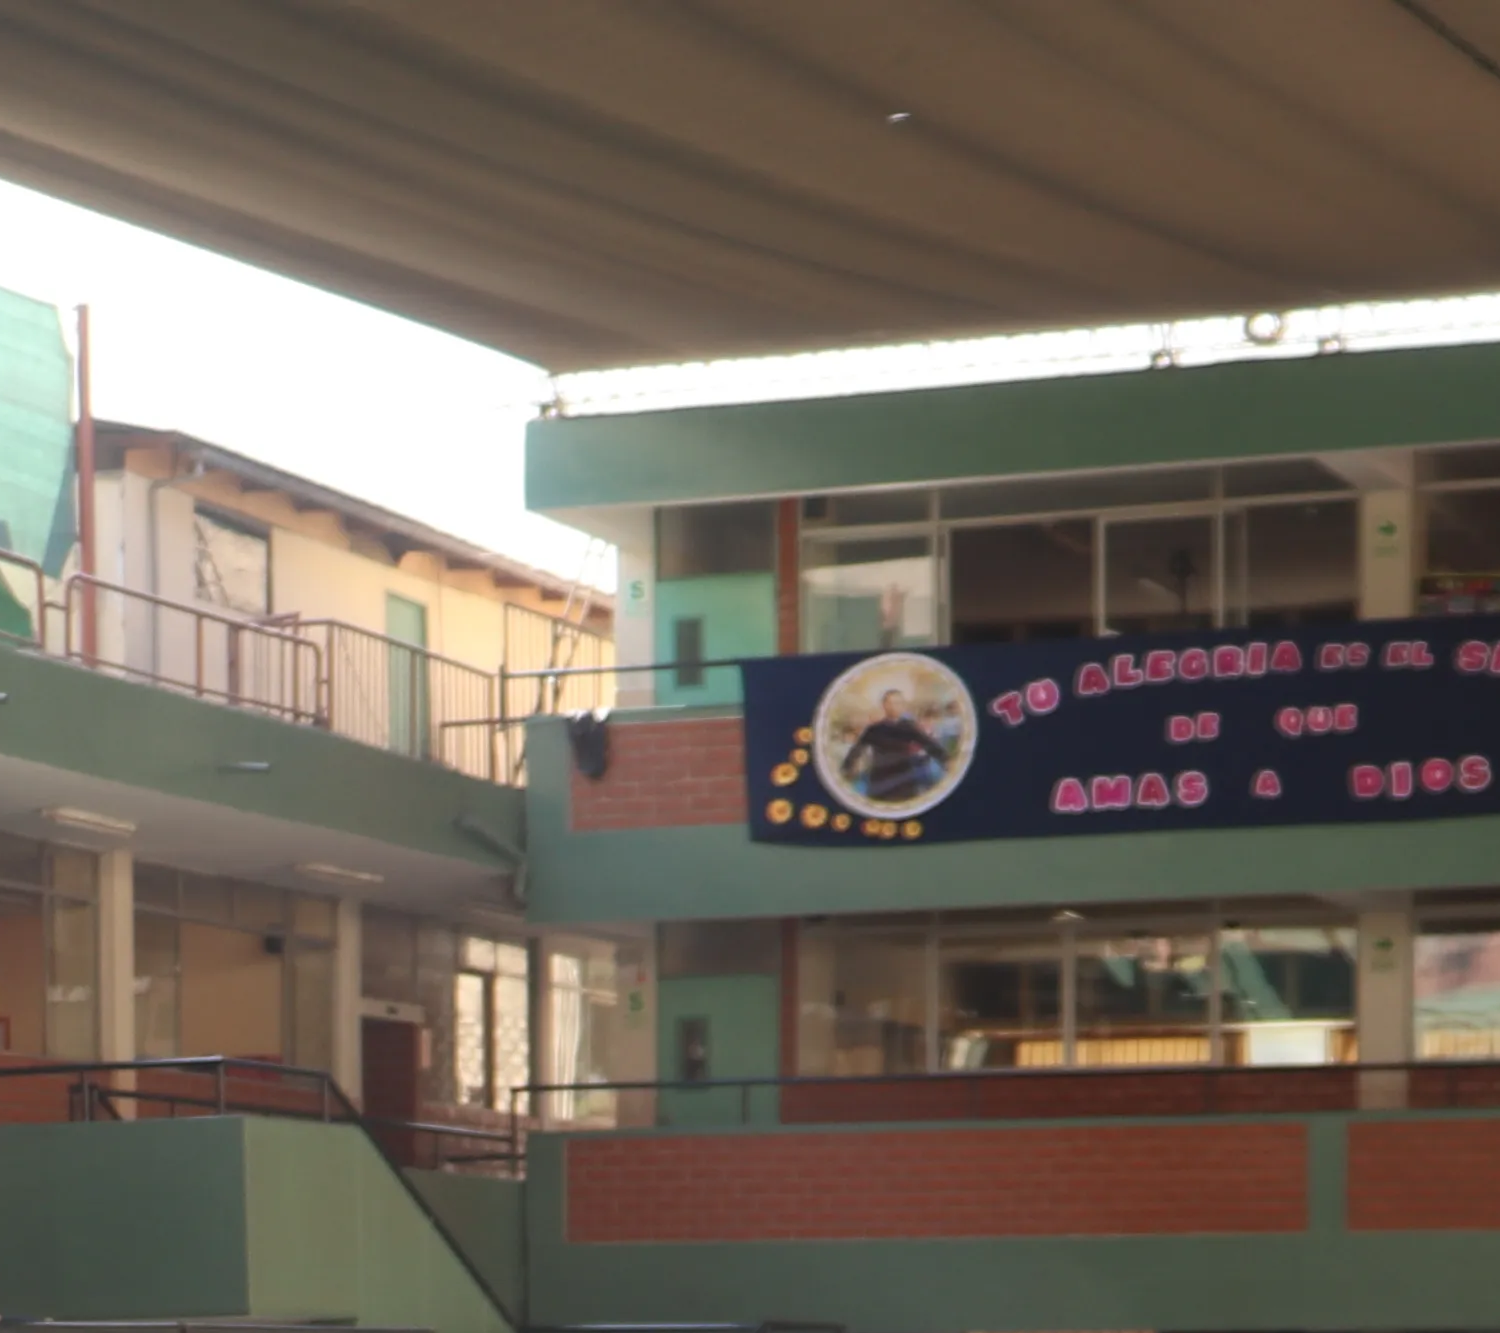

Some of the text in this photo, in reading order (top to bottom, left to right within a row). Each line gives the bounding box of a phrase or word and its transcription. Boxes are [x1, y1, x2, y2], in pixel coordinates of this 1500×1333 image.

[992, 678, 1060, 728] TU
[1077, 641, 1302, 696] ALEGRIA
[1320, 641, 1371, 669] ES
[1386, 641, 1435, 668] EL
[1168, 704, 1359, 742] DE QUE
[1055, 755, 1492, 812] AMAS A DIOS
